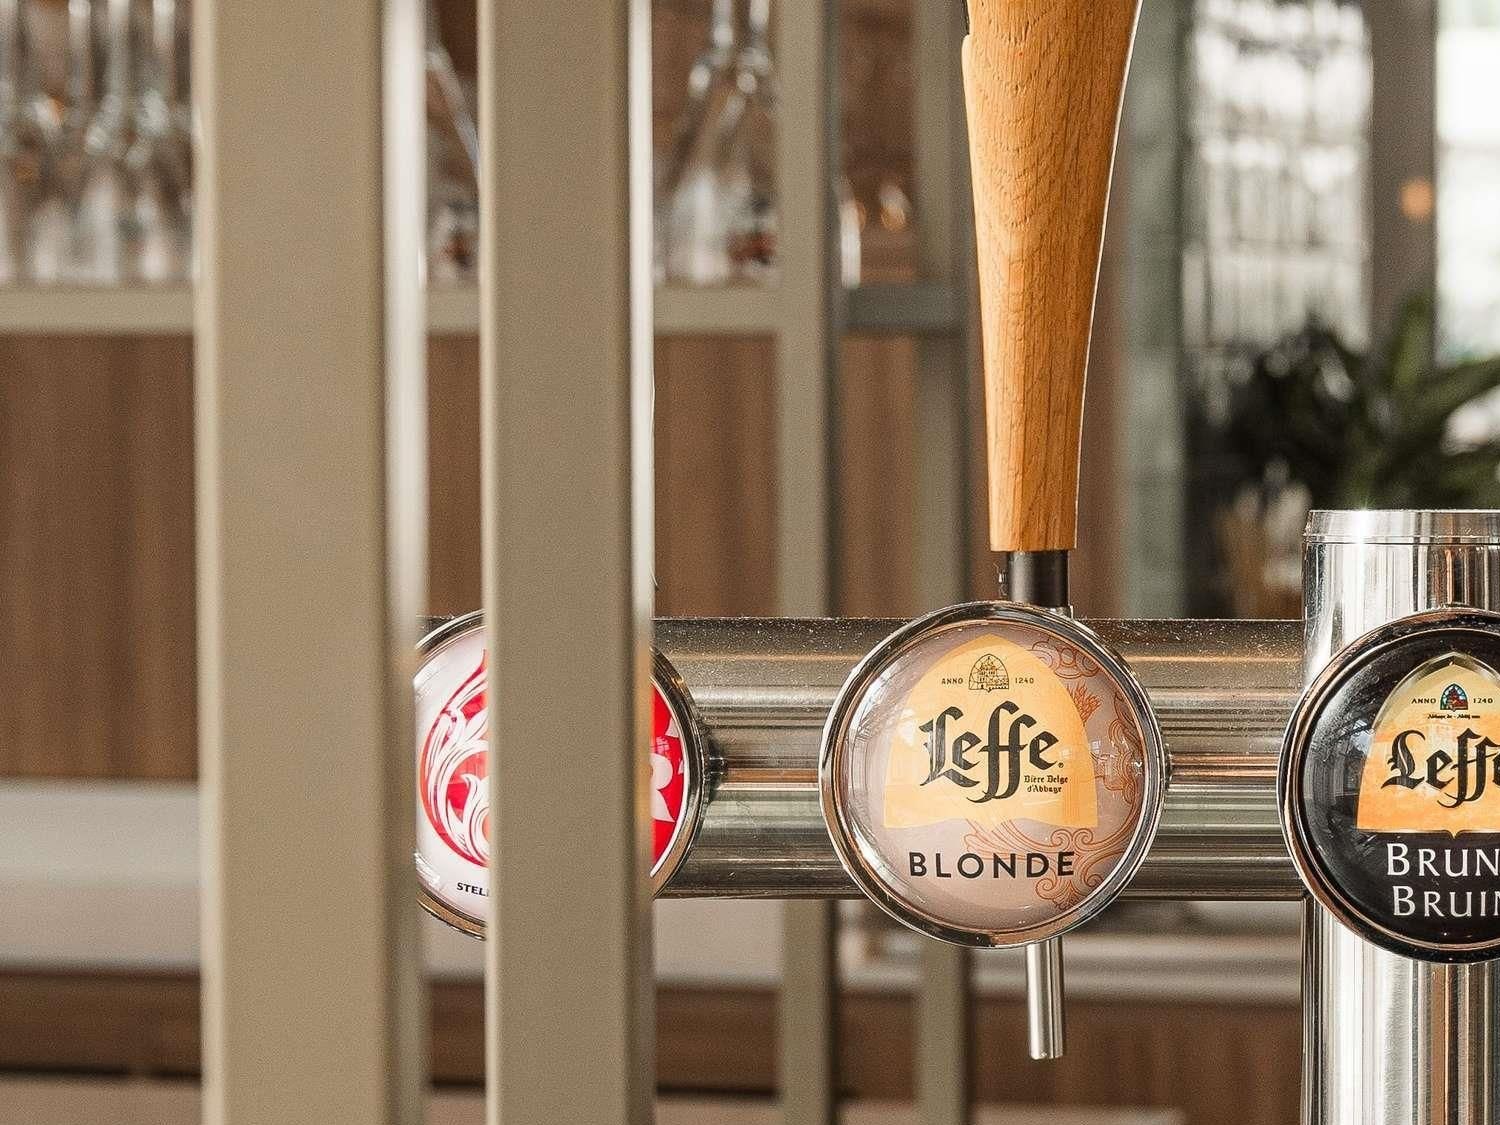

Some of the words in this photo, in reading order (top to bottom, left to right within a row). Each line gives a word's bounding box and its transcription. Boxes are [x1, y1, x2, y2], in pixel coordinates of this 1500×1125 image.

[941, 677, 964, 685] ANNO
[1015, 677, 1035, 685] 1240
[918, 700, 1060, 804] Leffe
[909, 851, 1075, 879] BLONDE
